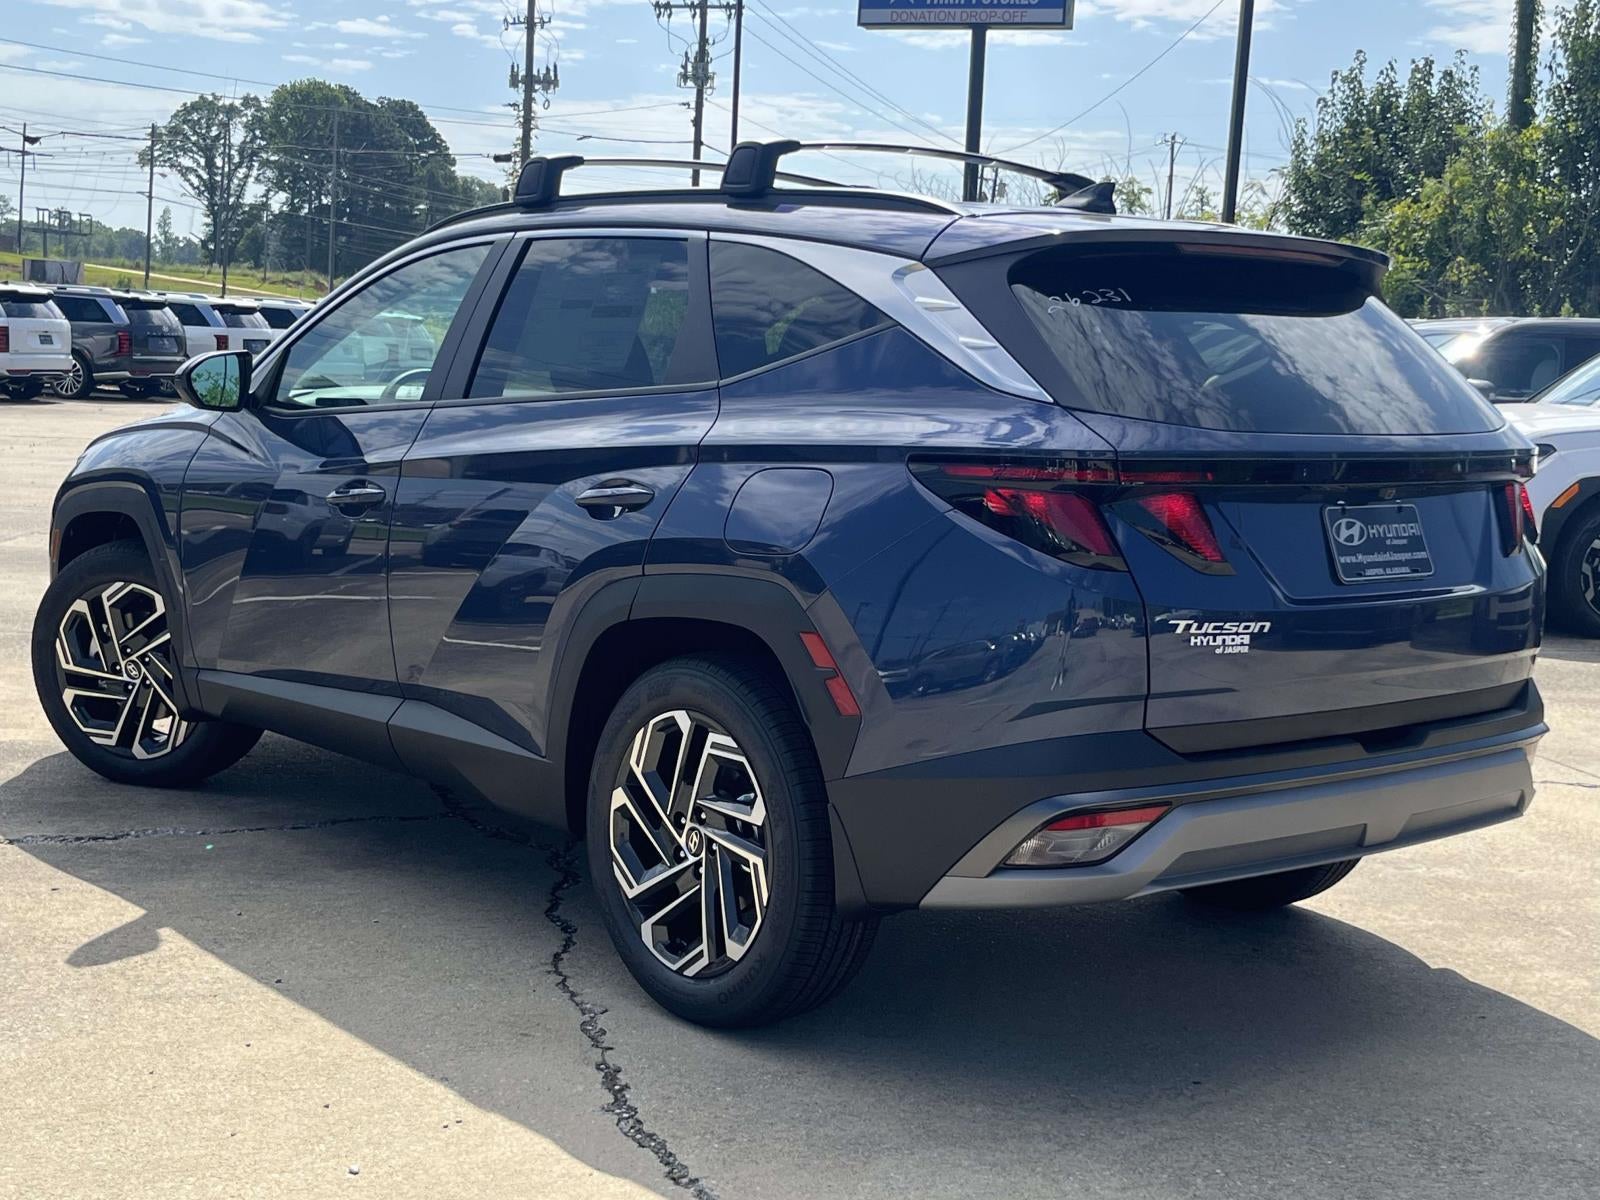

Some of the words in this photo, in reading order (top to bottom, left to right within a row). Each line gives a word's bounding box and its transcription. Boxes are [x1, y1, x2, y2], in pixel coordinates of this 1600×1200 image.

[890, 10, 956, 22] DONATION
[959, 10, 1028, 22] DROP-OFF
[1367, 523, 1421, 538] HYUNDAI
[1190, 634, 1250, 646] HYUNDAI
[1214, 645, 1223, 654] of
[1223, 645, 1249, 654] JASPER
